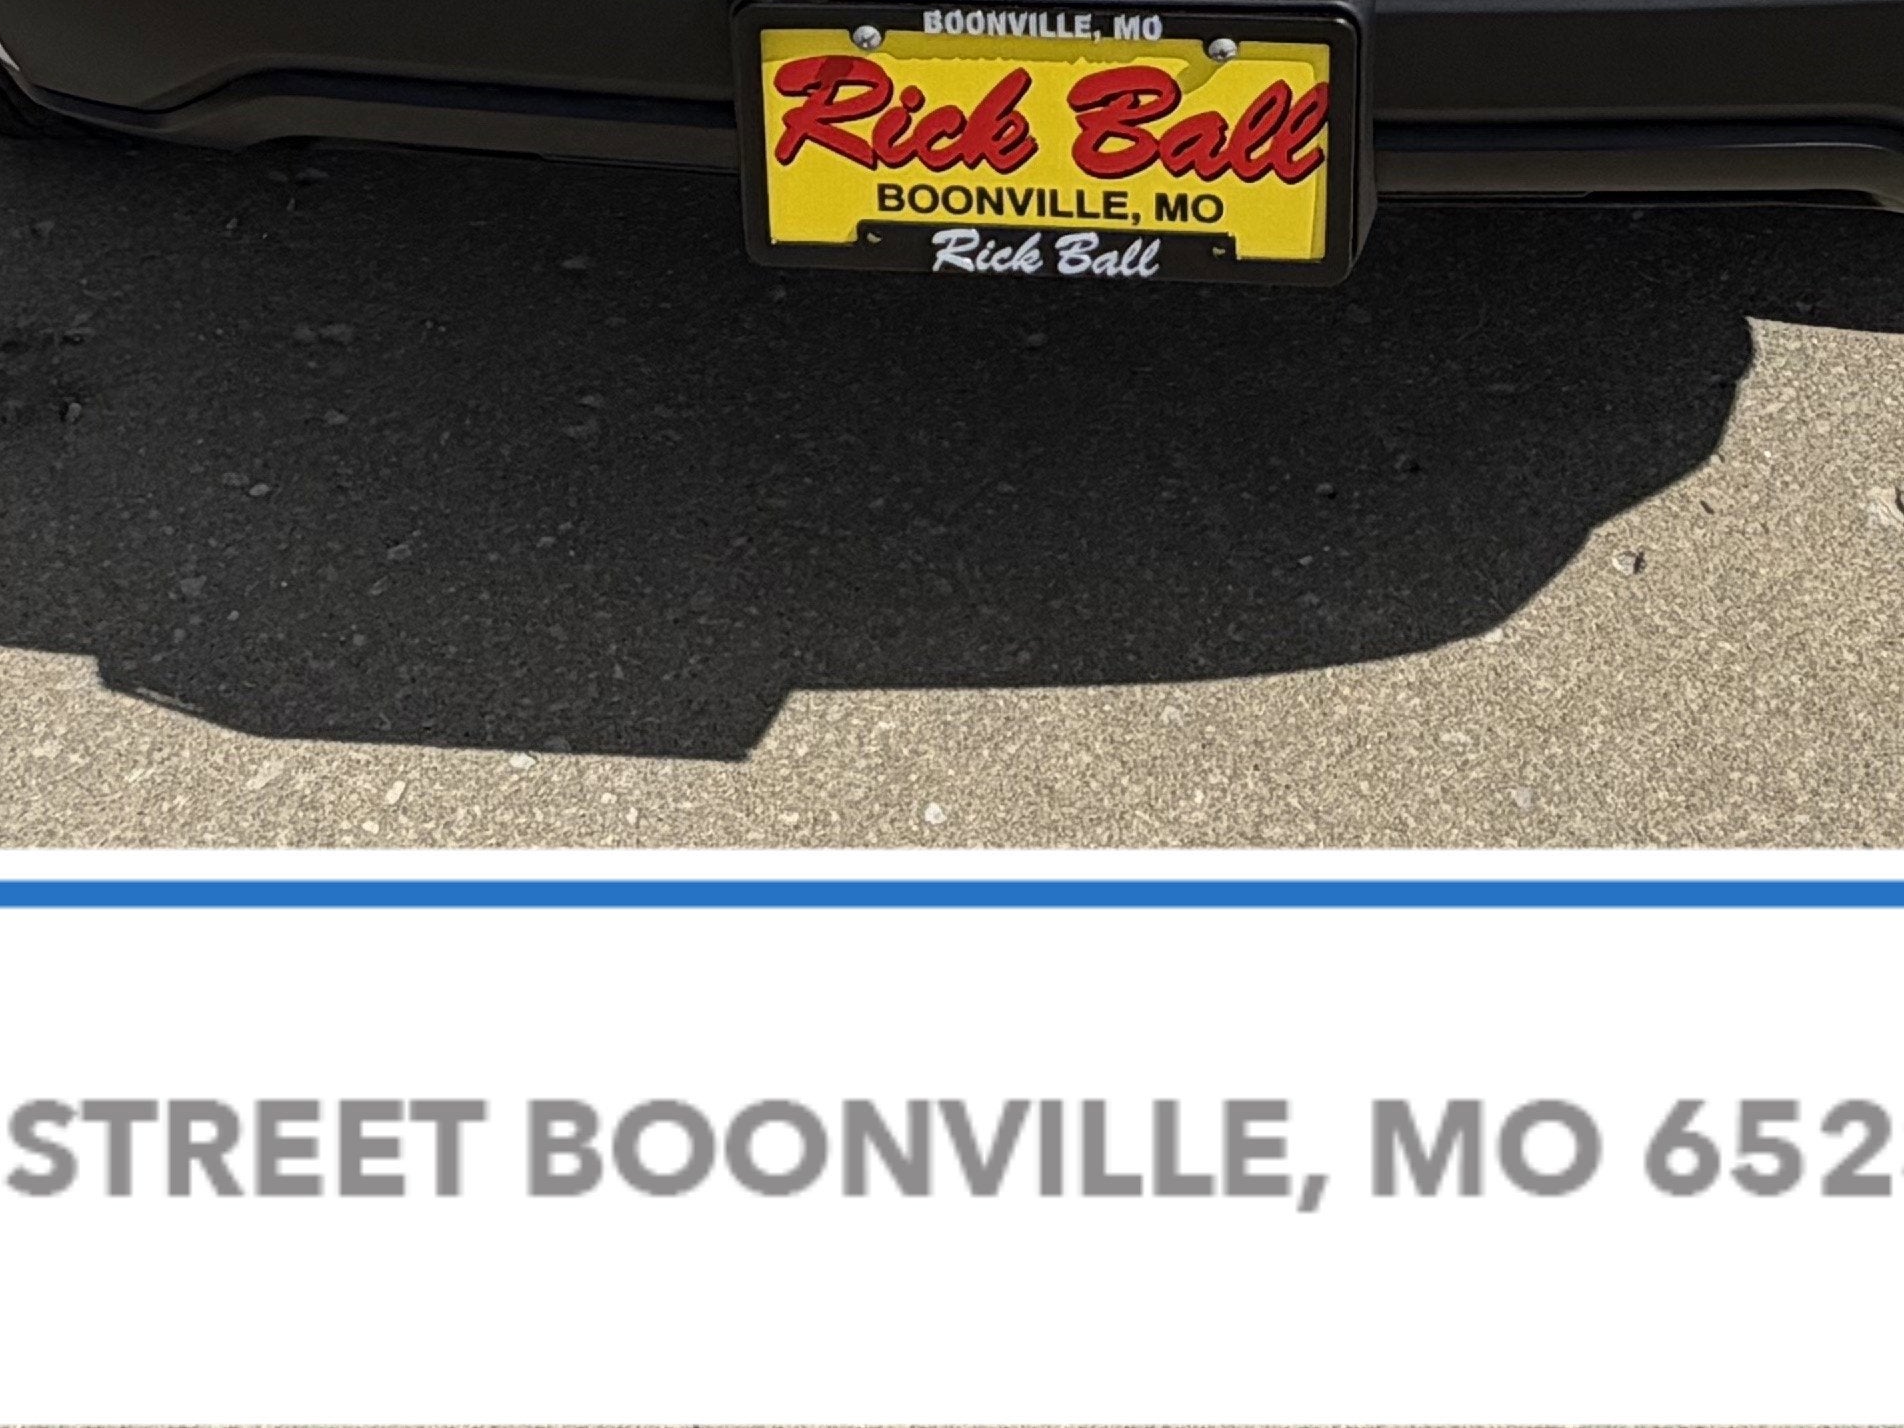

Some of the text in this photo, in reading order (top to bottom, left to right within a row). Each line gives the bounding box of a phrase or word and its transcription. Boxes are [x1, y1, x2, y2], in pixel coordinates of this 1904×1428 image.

[922, 9, 1163, 43] BOONVILLE, MO
[773, 54, 1330, 183] Rick Ball
[876, 182, 1225, 226] BOONVILLE, MO
[932, 227, 1161, 278] Rick Ball
